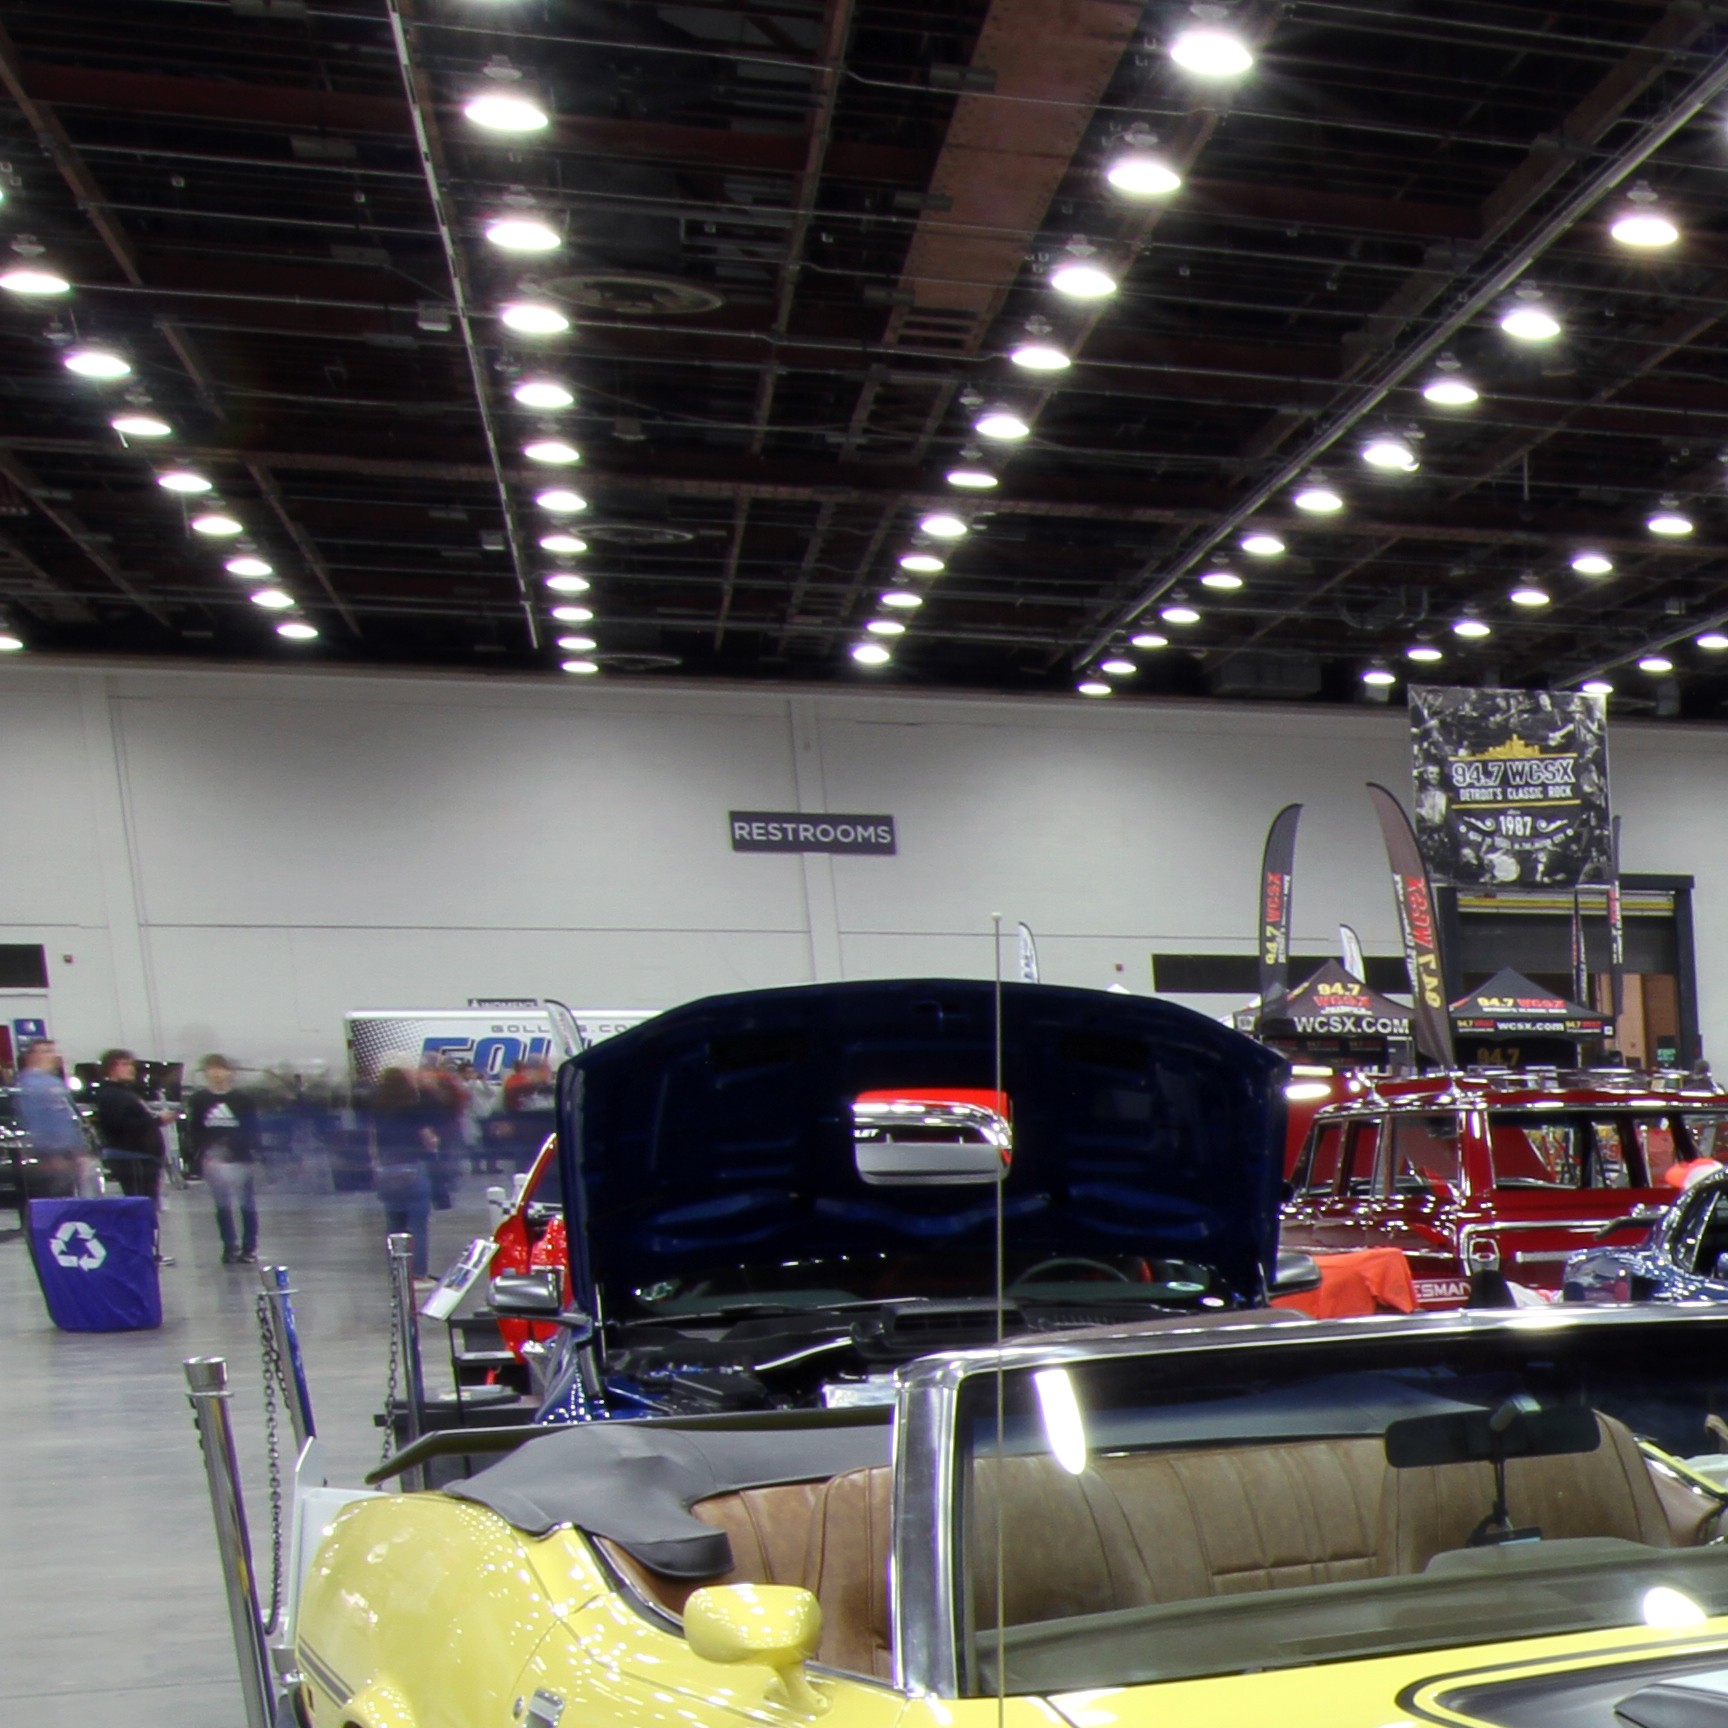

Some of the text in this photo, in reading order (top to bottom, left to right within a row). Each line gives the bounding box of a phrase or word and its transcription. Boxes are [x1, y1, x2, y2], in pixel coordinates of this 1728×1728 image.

[1451, 758, 1577, 787] 94.7 WCSX
[1459, 785, 1572, 801] DETROIT'S CLASSIC ROCK
[734, 822, 891, 844] RESTROOMS
[1499, 816, 1532, 836] 1987
[1316, 982, 1360, 996] 94.7
[1294, 1016, 1409, 1034] WCSX.COM
